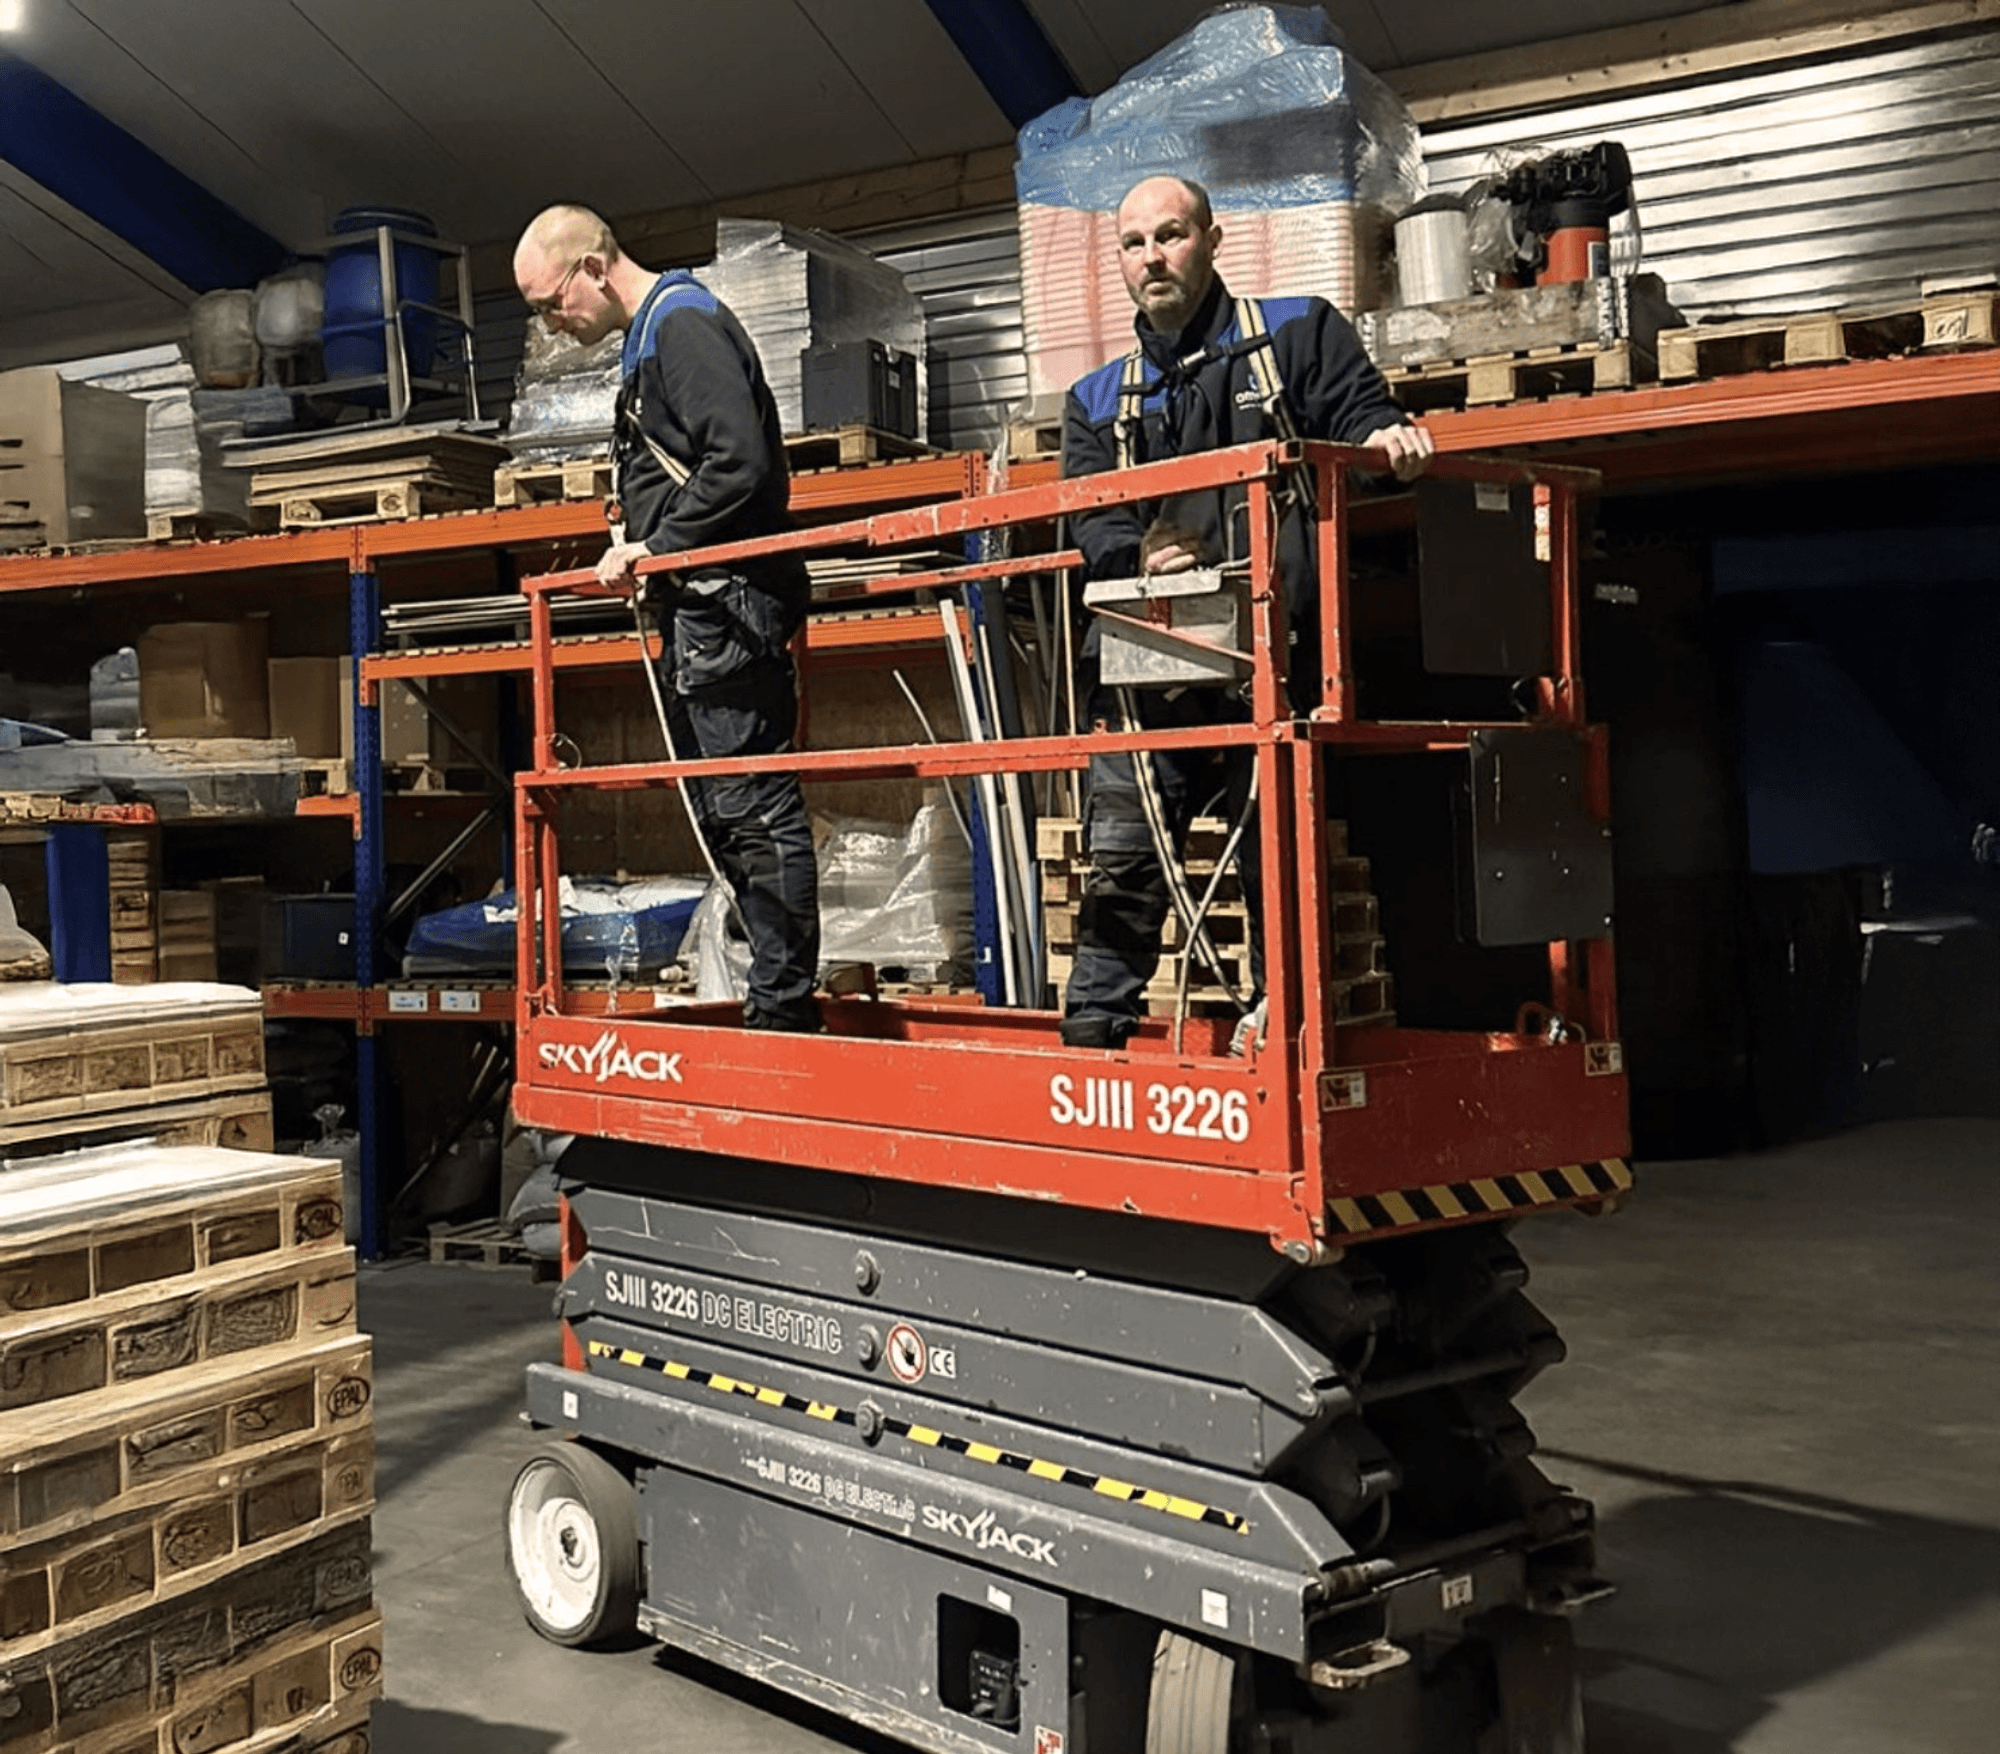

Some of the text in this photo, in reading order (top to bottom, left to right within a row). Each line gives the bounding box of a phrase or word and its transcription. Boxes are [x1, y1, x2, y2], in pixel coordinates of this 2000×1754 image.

[538, 1030, 684, 1083] SKYJACK
[1050, 1074, 1250, 1143] SJIII 3226
[605, 1270, 843, 1354] SJIII 3226 DC ELECTRIC
[788, 1465, 822, 1495] 3226
[922, 1505, 1059, 1568] SKYJACK
